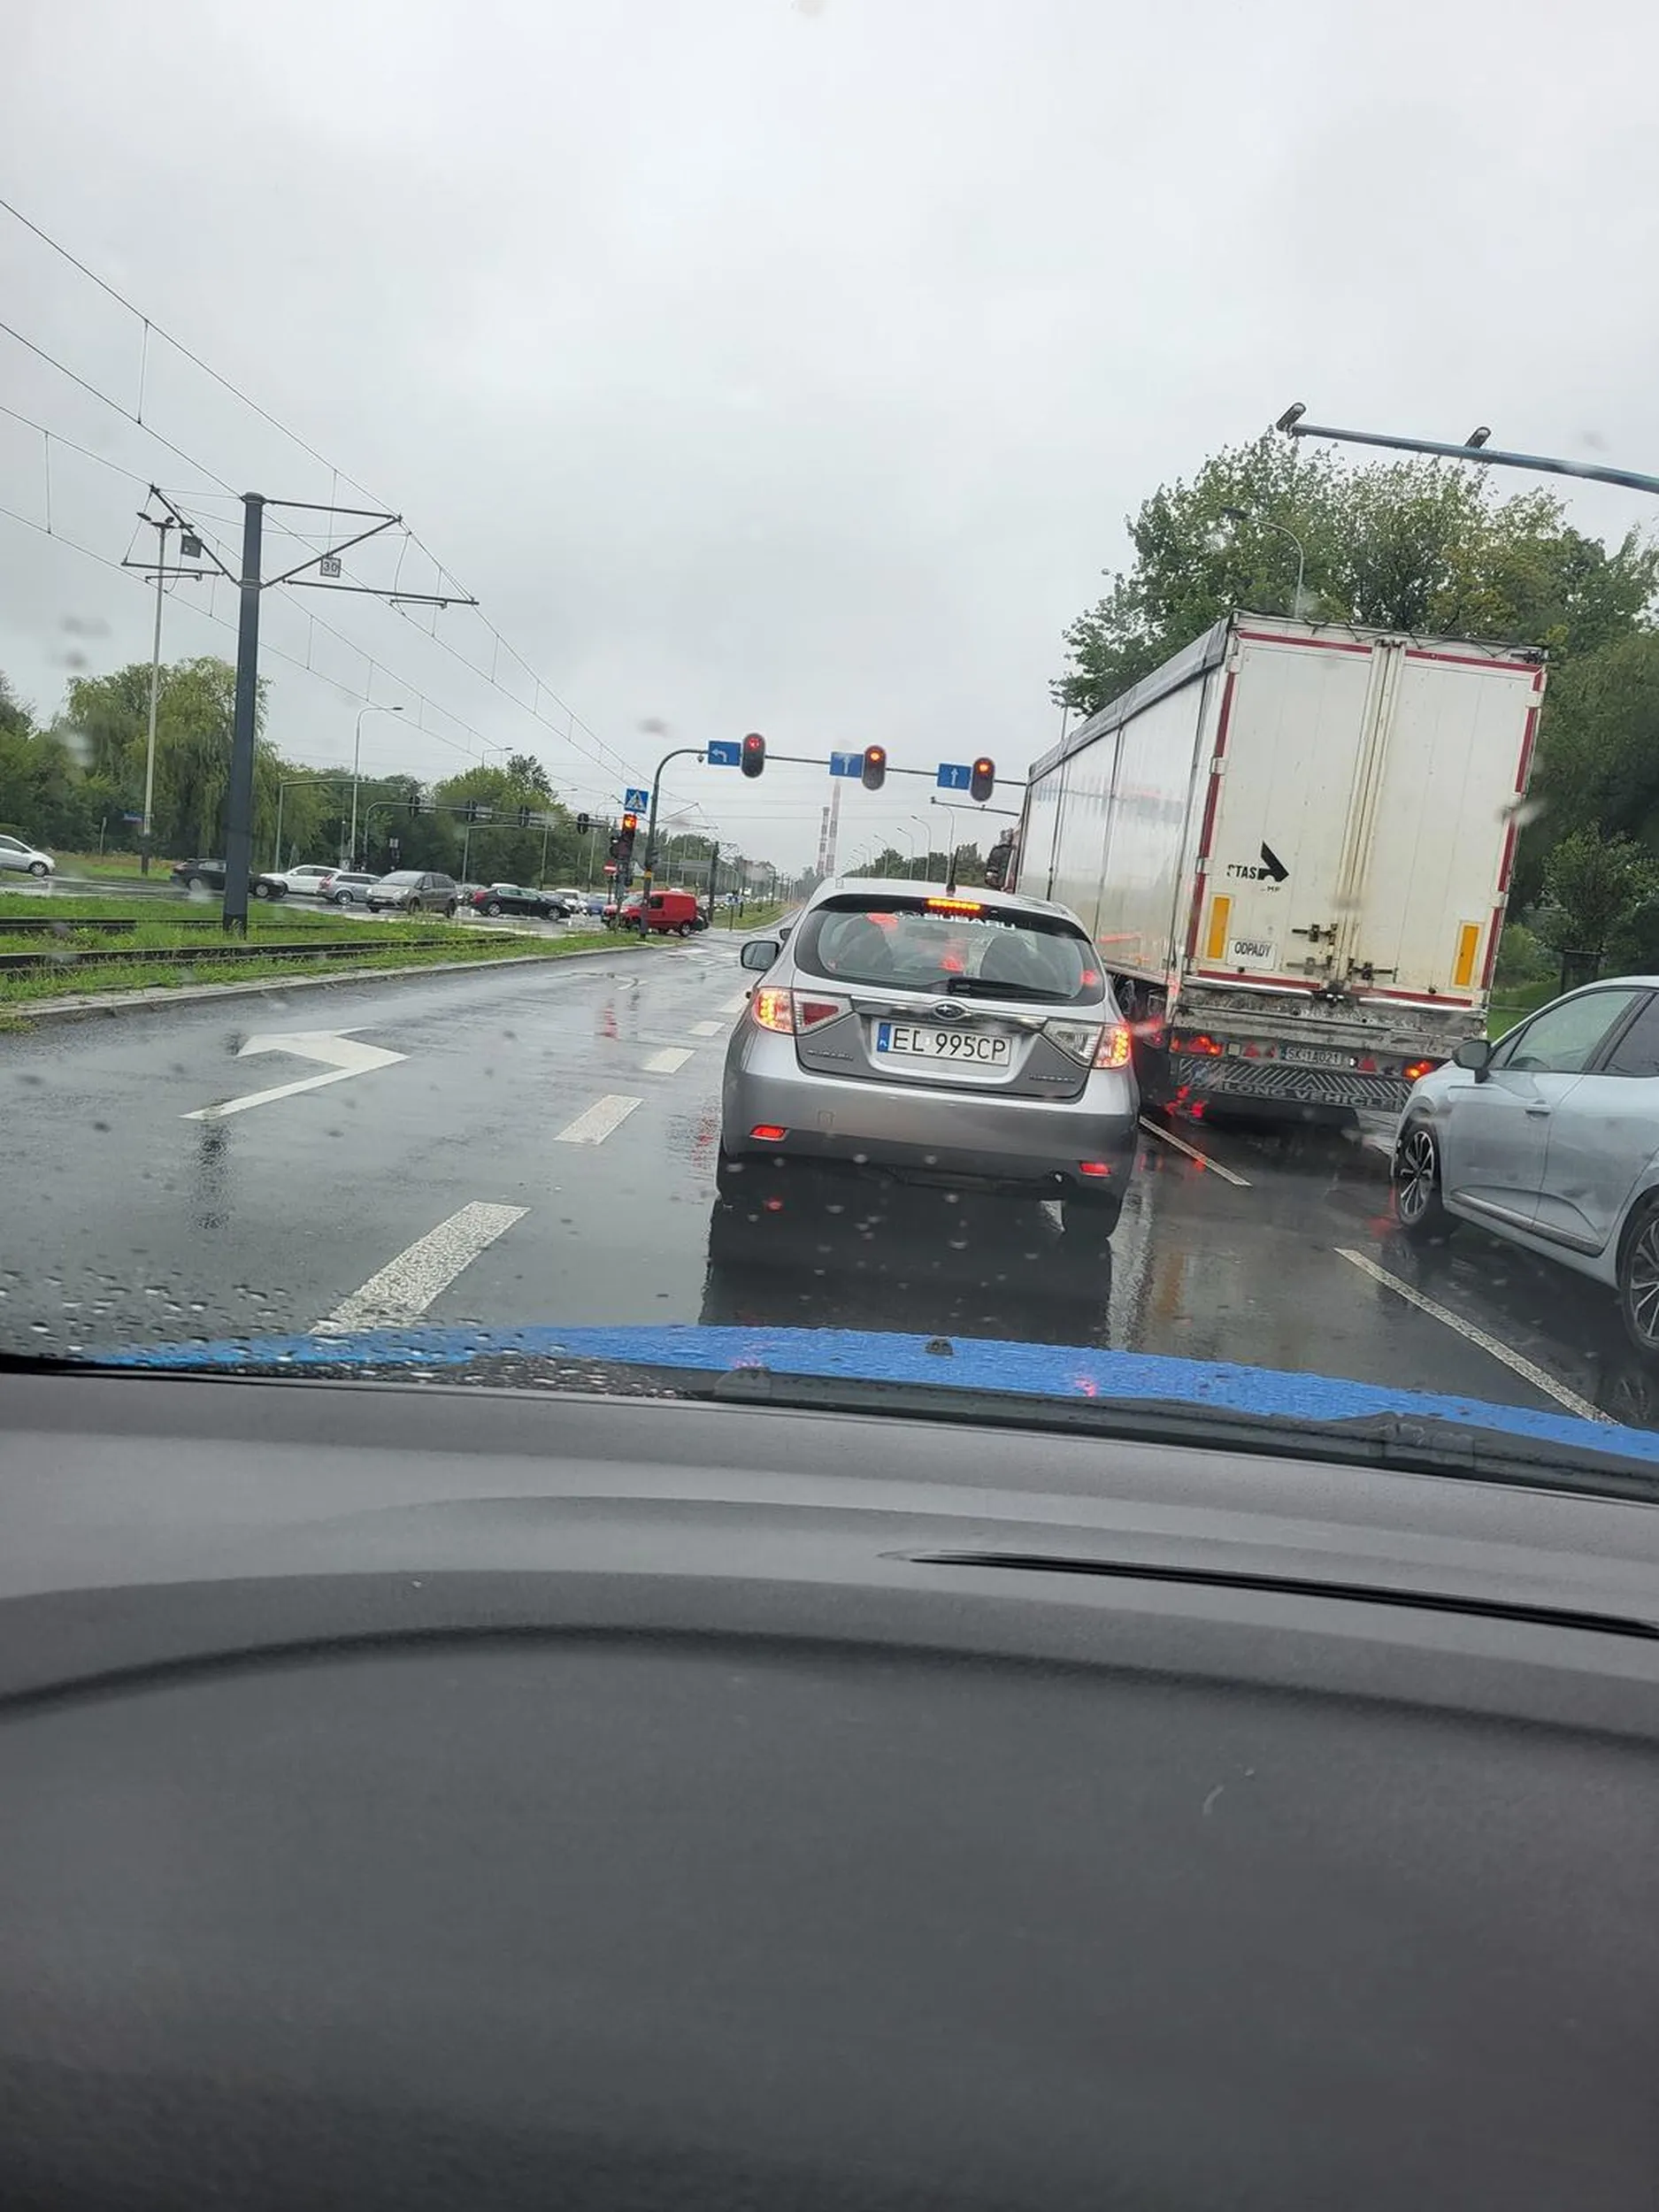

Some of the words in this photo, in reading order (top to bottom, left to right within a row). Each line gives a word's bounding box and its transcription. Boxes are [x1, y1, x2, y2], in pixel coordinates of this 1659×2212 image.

[324, 561, 337, 572] 30
[924, 912, 1016, 930] SUBARU
[1234, 941, 1271, 958] ODPADY
[894, 1027, 925, 1052] EL
[935, 1032, 1006, 1061] 995CP
[1225, 1082, 1286, 1096] LONG
